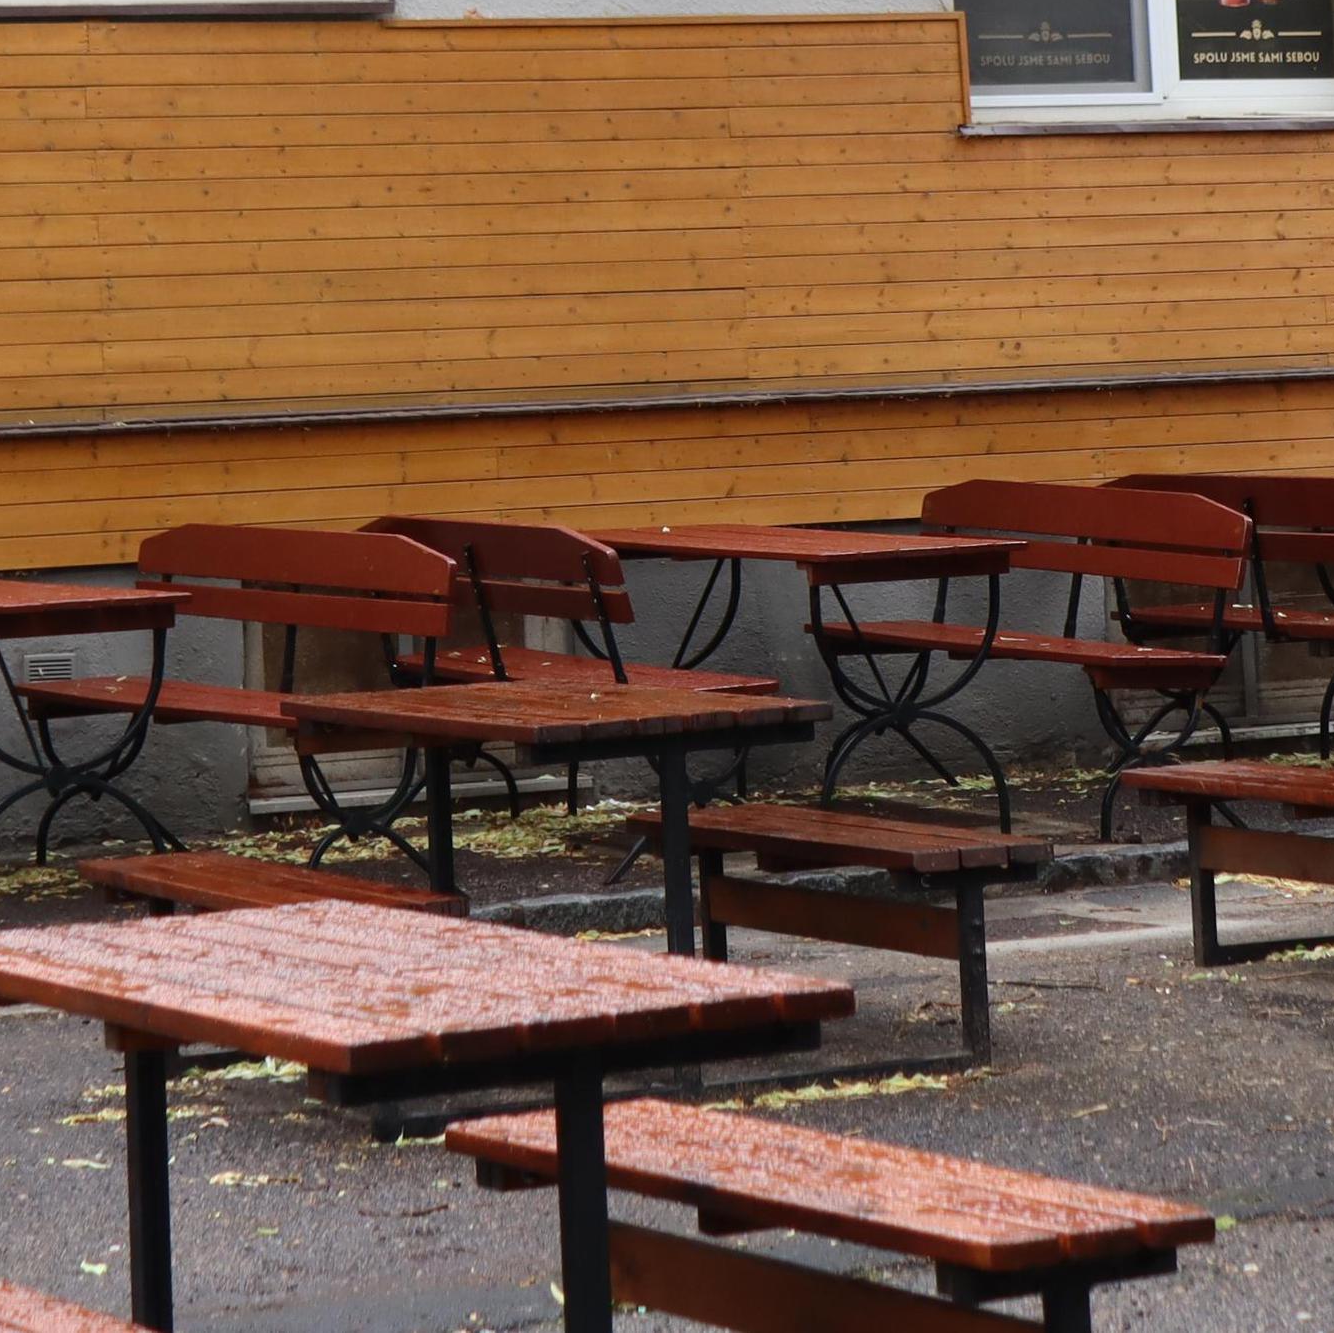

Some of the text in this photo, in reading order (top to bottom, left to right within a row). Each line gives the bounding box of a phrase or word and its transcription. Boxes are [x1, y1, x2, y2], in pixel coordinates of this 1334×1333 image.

[980, 53, 1111, 67] SPOLU JSME SAMI SEBOU
[1193, 52, 1320, 64] SPOLU JSME SAMI SEBOU
